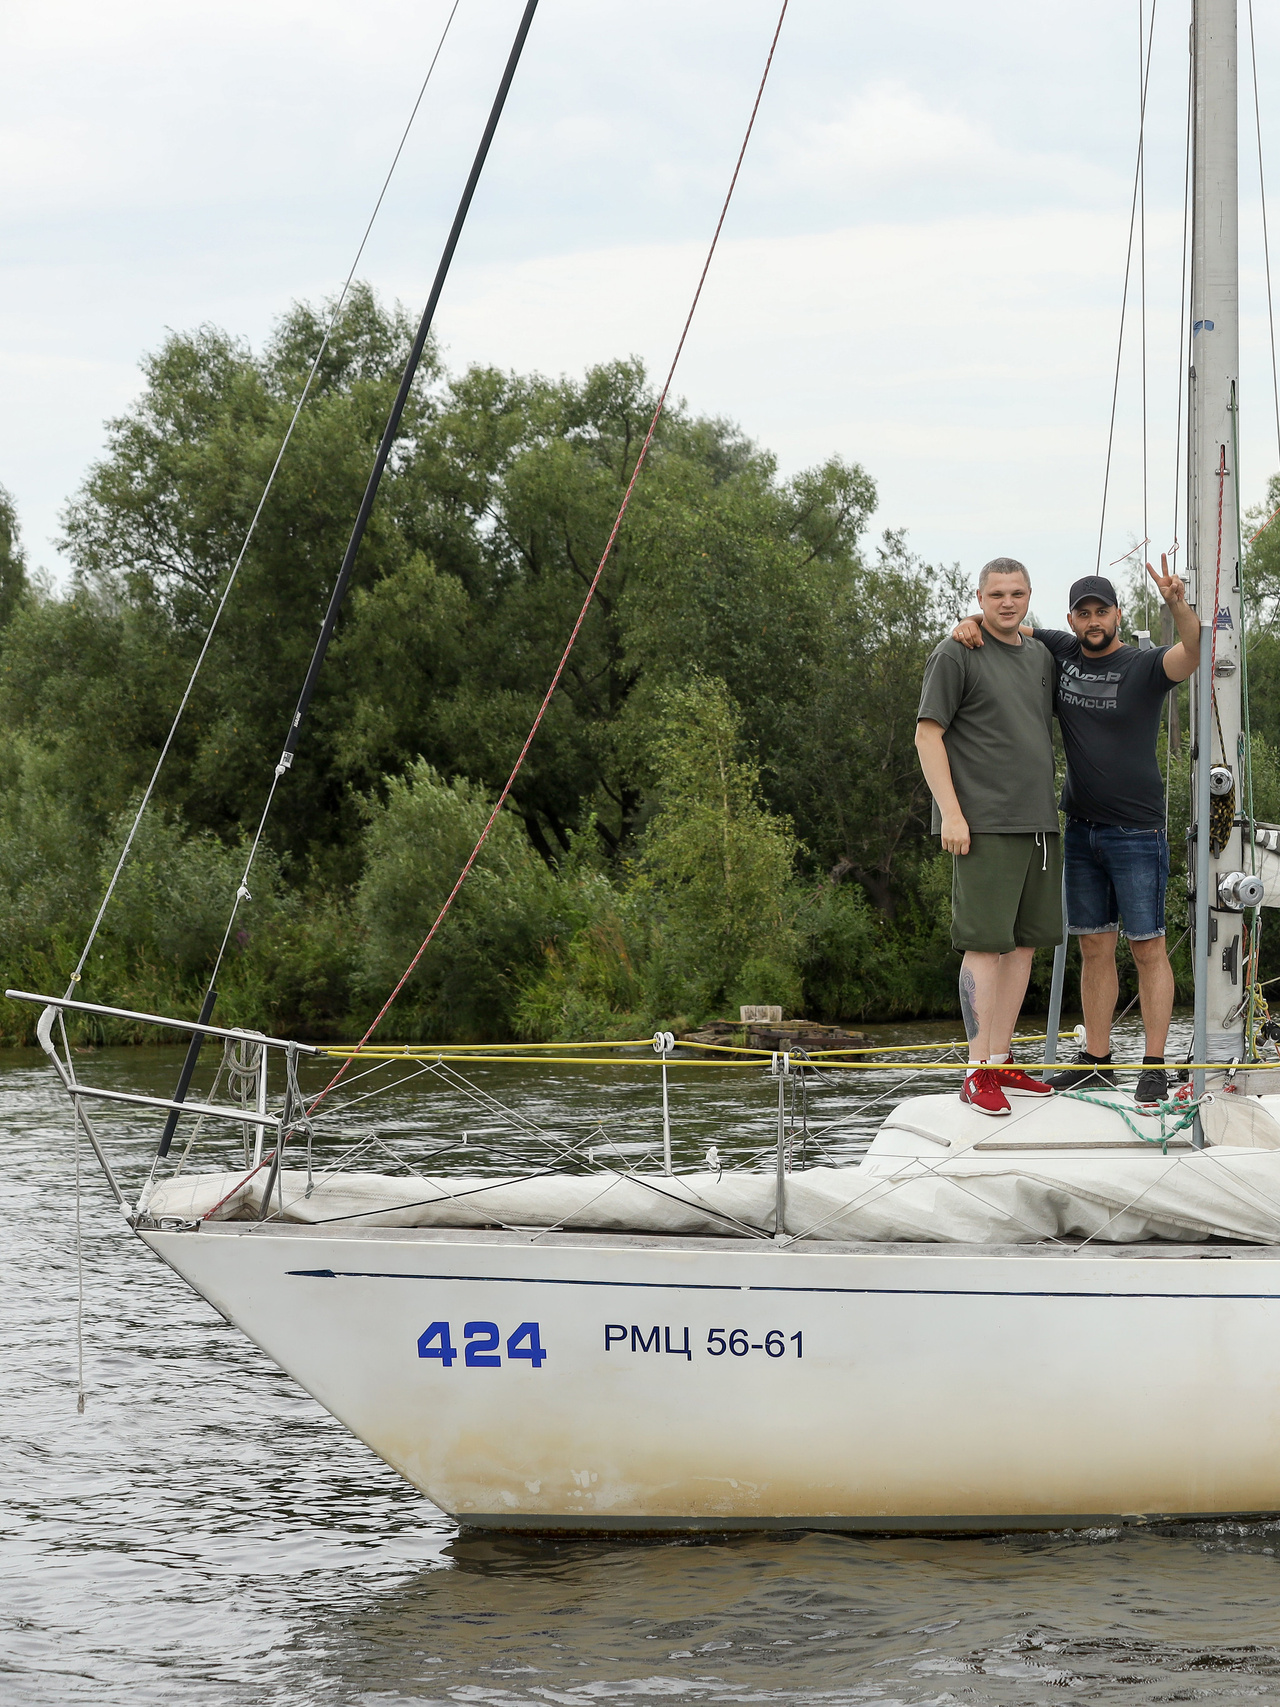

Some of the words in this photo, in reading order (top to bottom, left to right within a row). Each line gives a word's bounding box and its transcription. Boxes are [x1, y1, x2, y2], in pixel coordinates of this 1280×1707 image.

[1062, 660, 1121, 682] UNDER
[1058, 689, 1117, 709] ARMOUR
[417, 1321, 547, 1368] 424
[604, 1324, 692, 1361] РМЦ
[706, 1328, 803, 1359] 56-61
